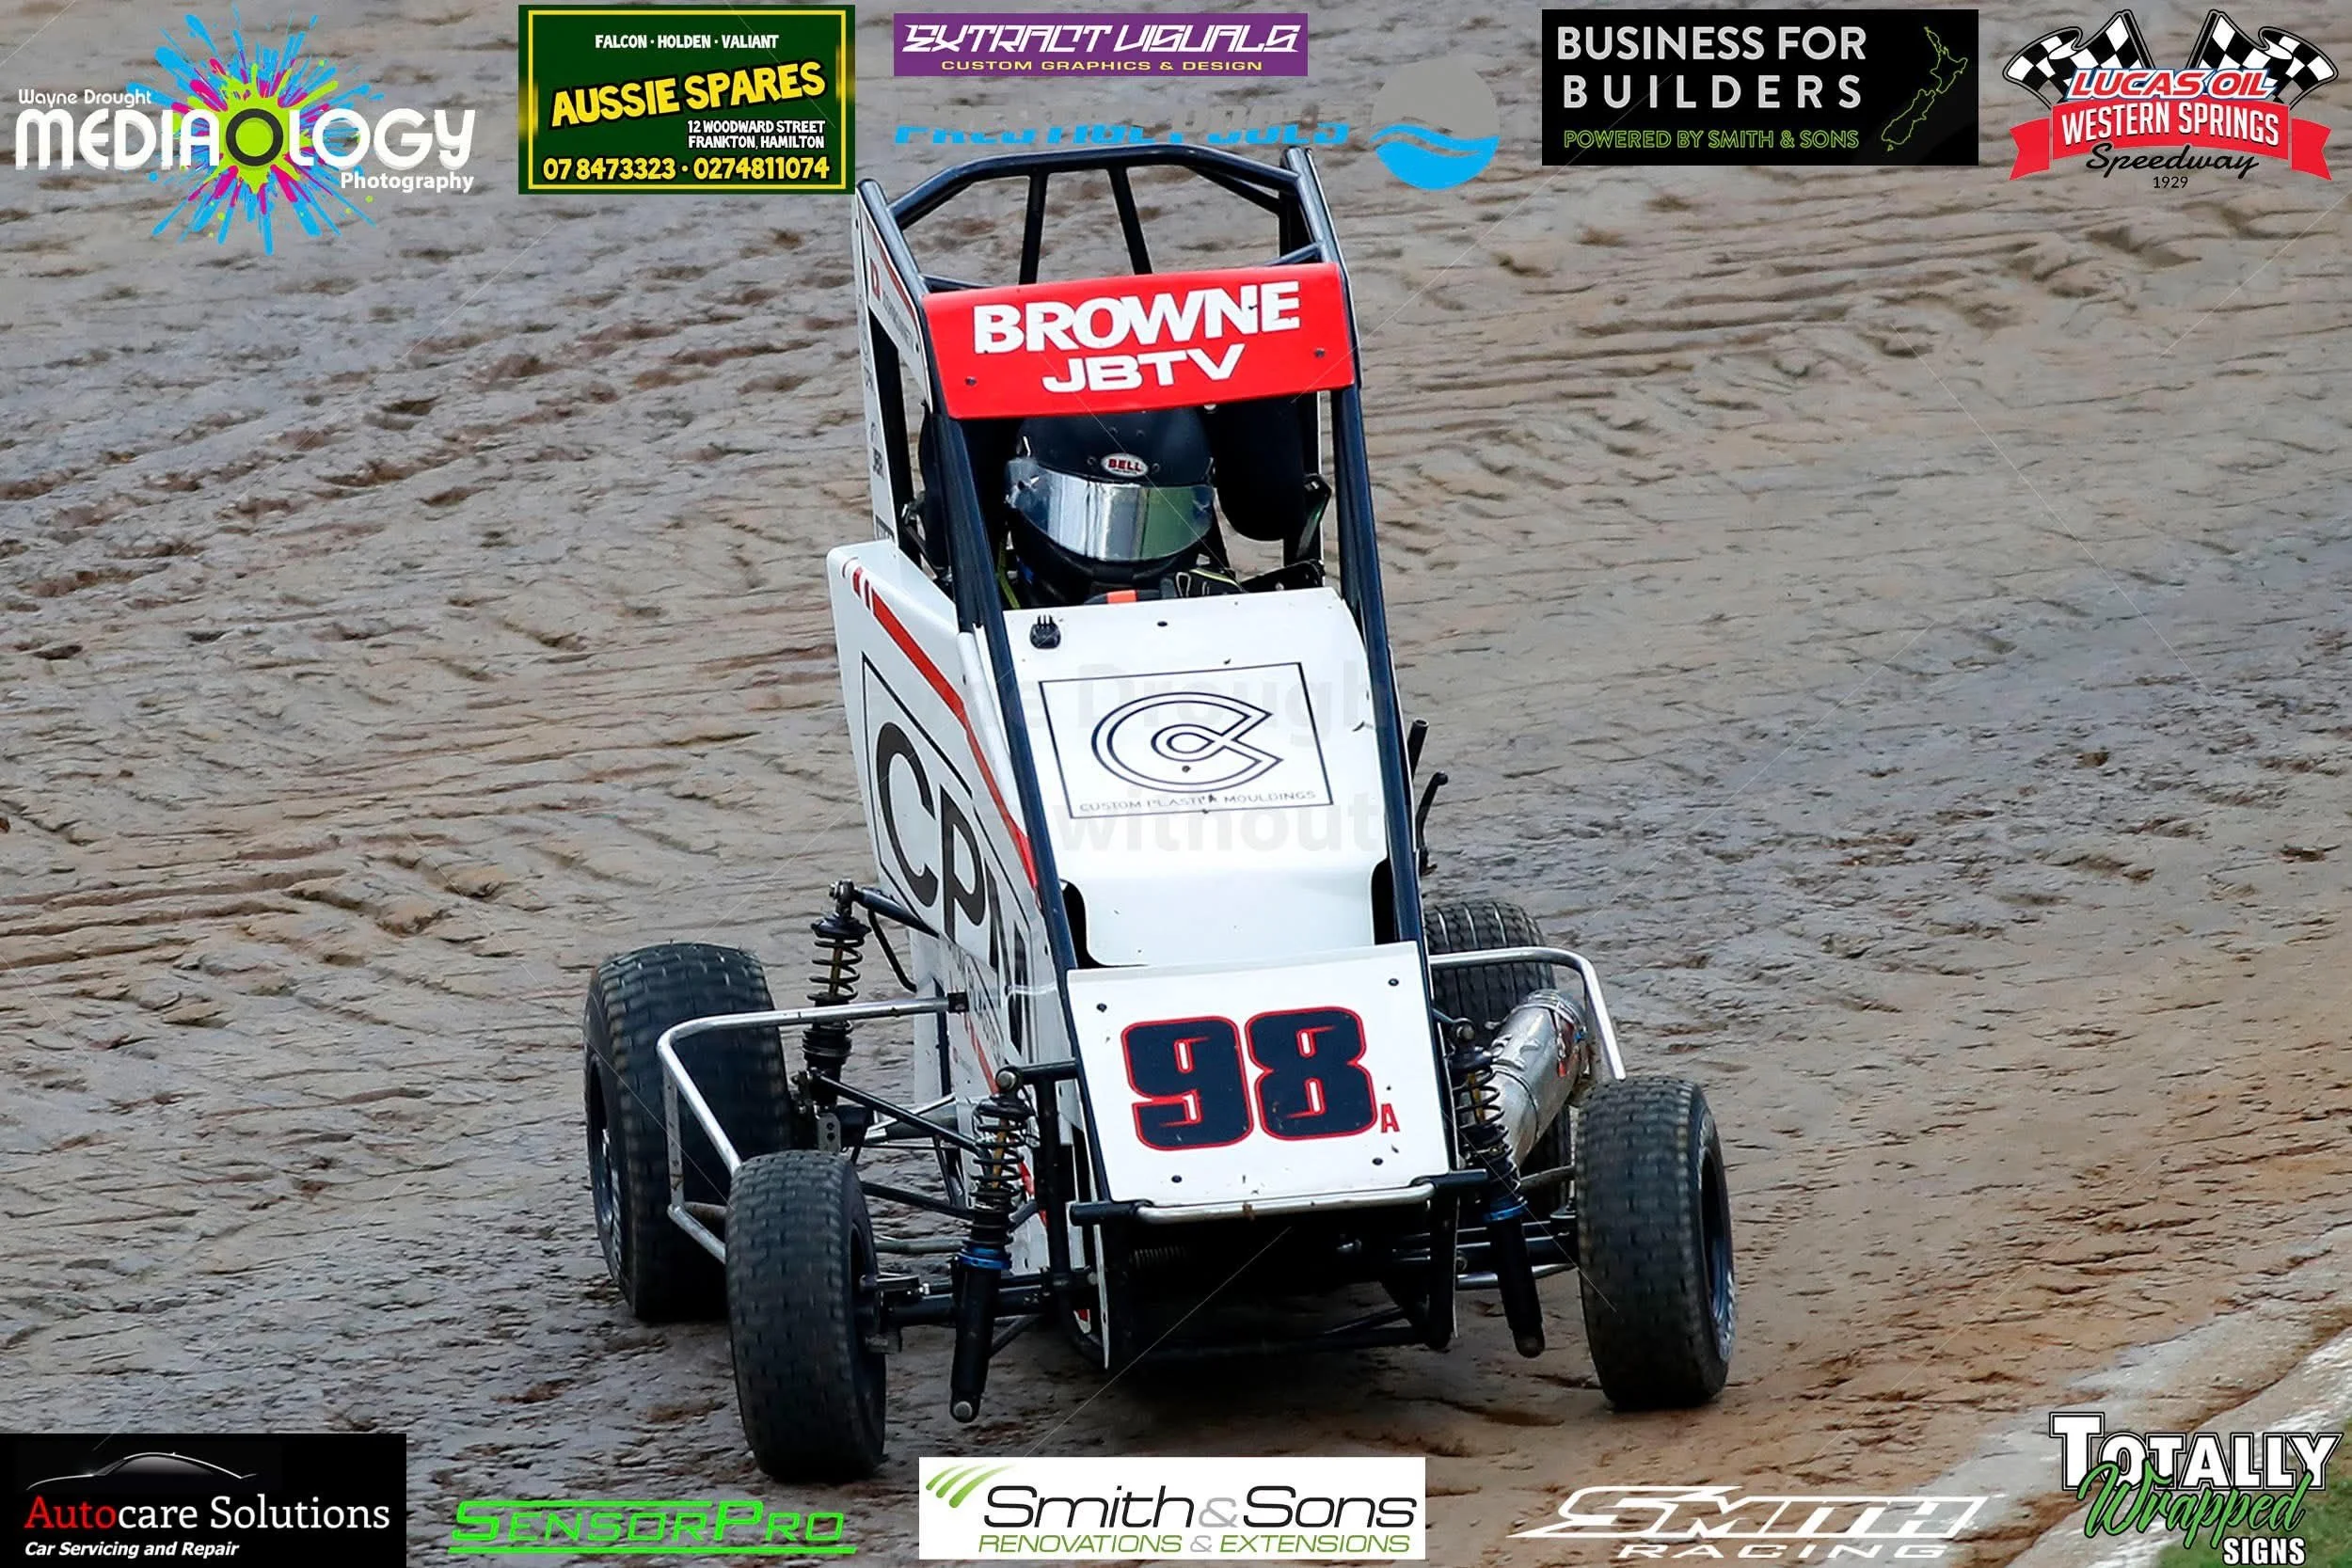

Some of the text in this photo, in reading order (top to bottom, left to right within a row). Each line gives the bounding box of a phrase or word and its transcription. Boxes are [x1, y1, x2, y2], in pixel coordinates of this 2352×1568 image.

[972, 280, 1301, 355] BROWNE
[1041, 342, 1246, 393] JBTV
[1108, 458, 1141, 472] BELL
[1079, 800, 1142, 813] CUSTOM
[1224, 790, 1317, 803] MOULDINGS
[1120, 1006, 1400, 1151] 98 A
